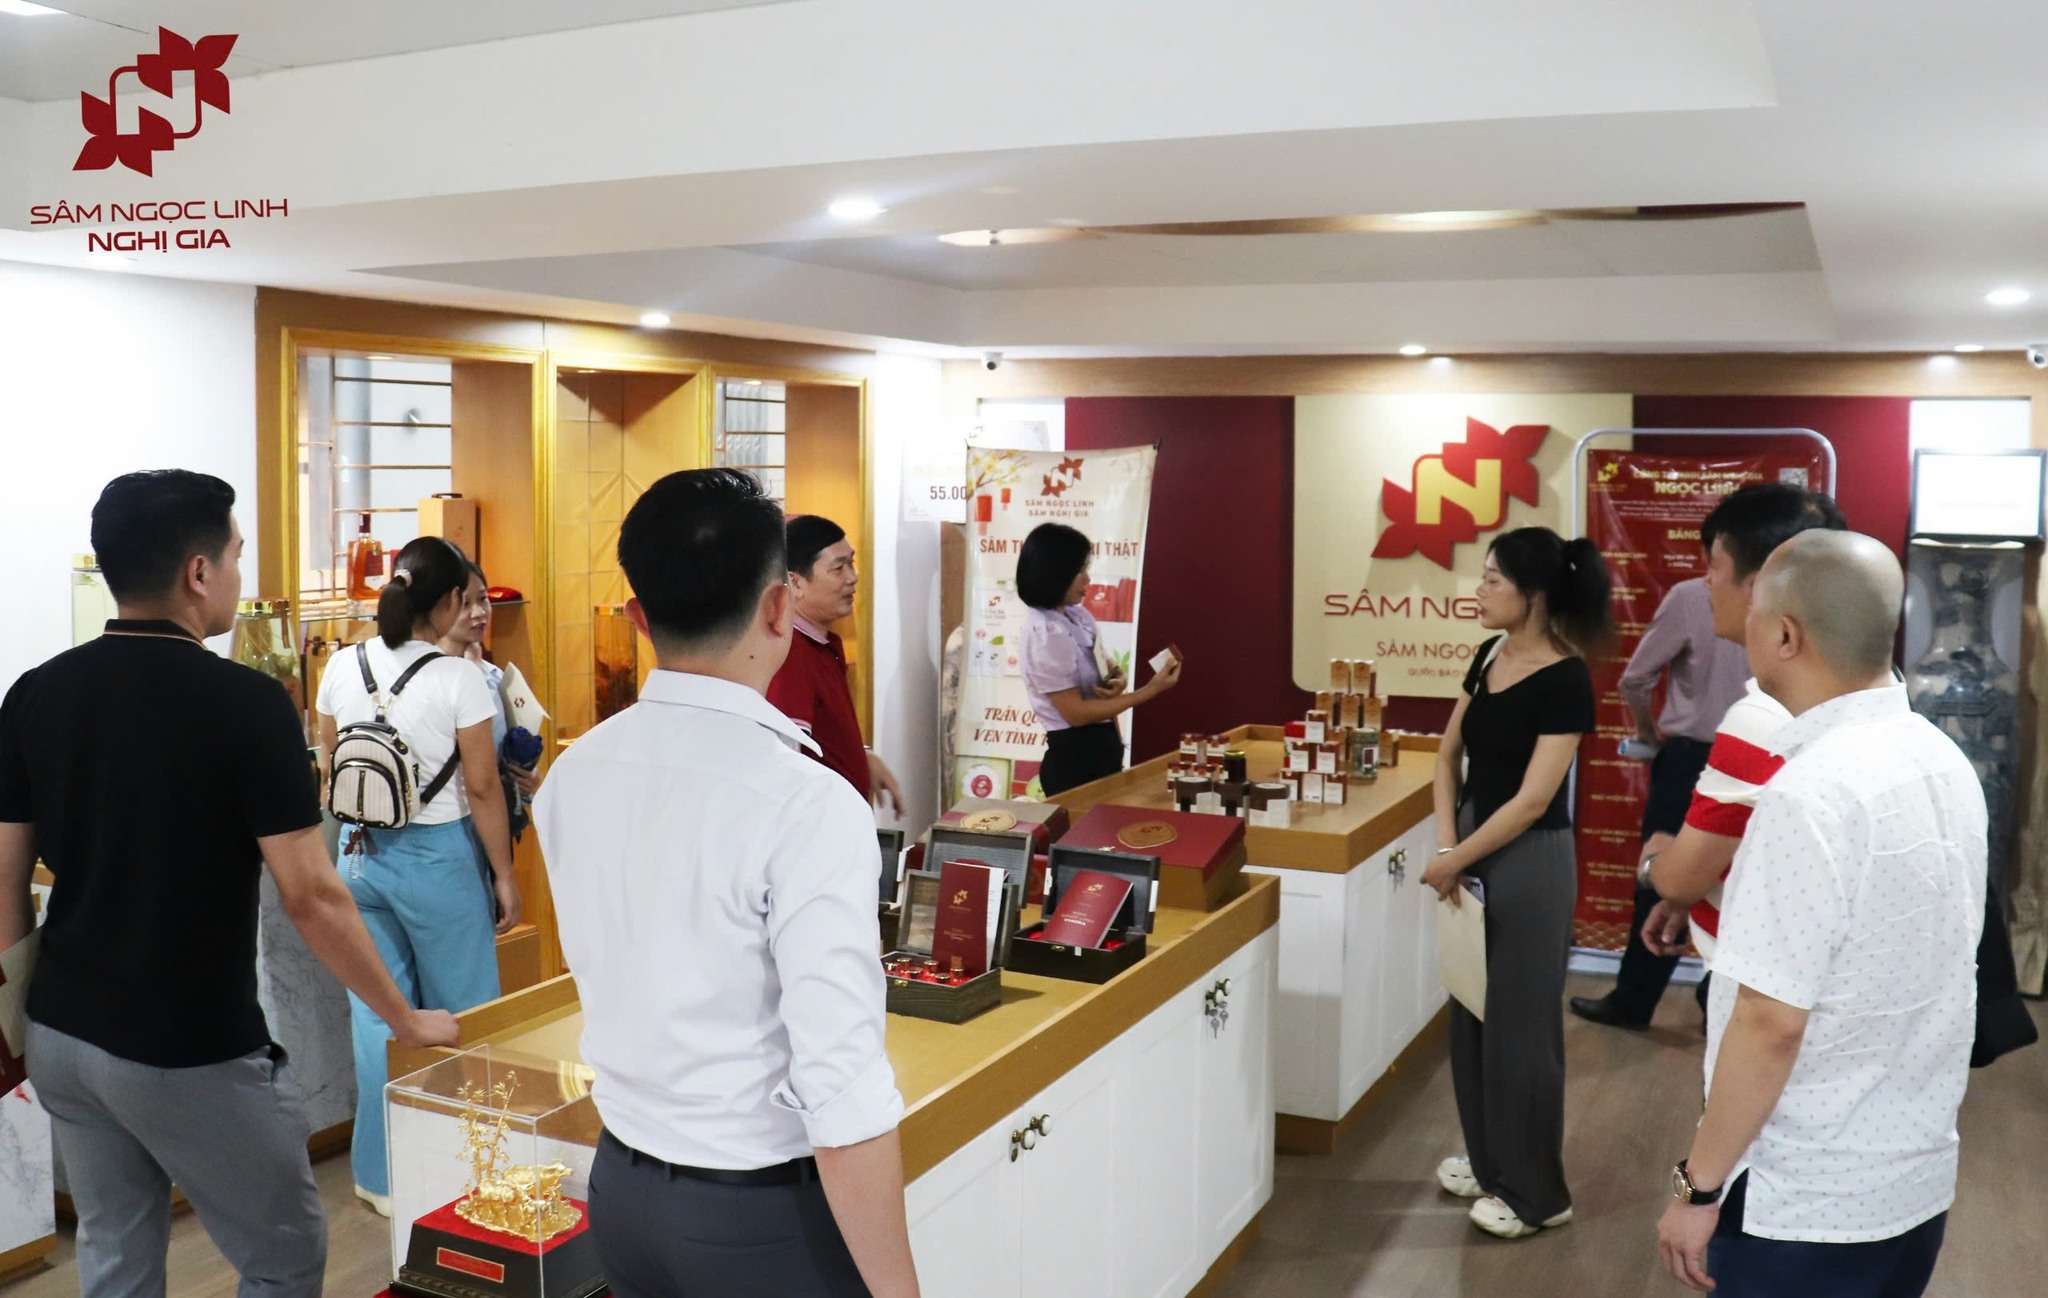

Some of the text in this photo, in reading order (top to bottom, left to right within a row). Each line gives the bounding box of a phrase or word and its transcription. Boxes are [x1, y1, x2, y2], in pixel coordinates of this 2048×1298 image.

[1654, 481, 1701, 497] NGỌC
[980, 535, 1007, 553] SÂM
[1104, 538, 1139, 560] THẬT
[1324, 588, 1480, 620] SÂM NG
[1376, 637, 1417, 657] SÂM
[974, 728, 1003, 746] VẸN
[1005, 728, 1038, 746] TÌNH
